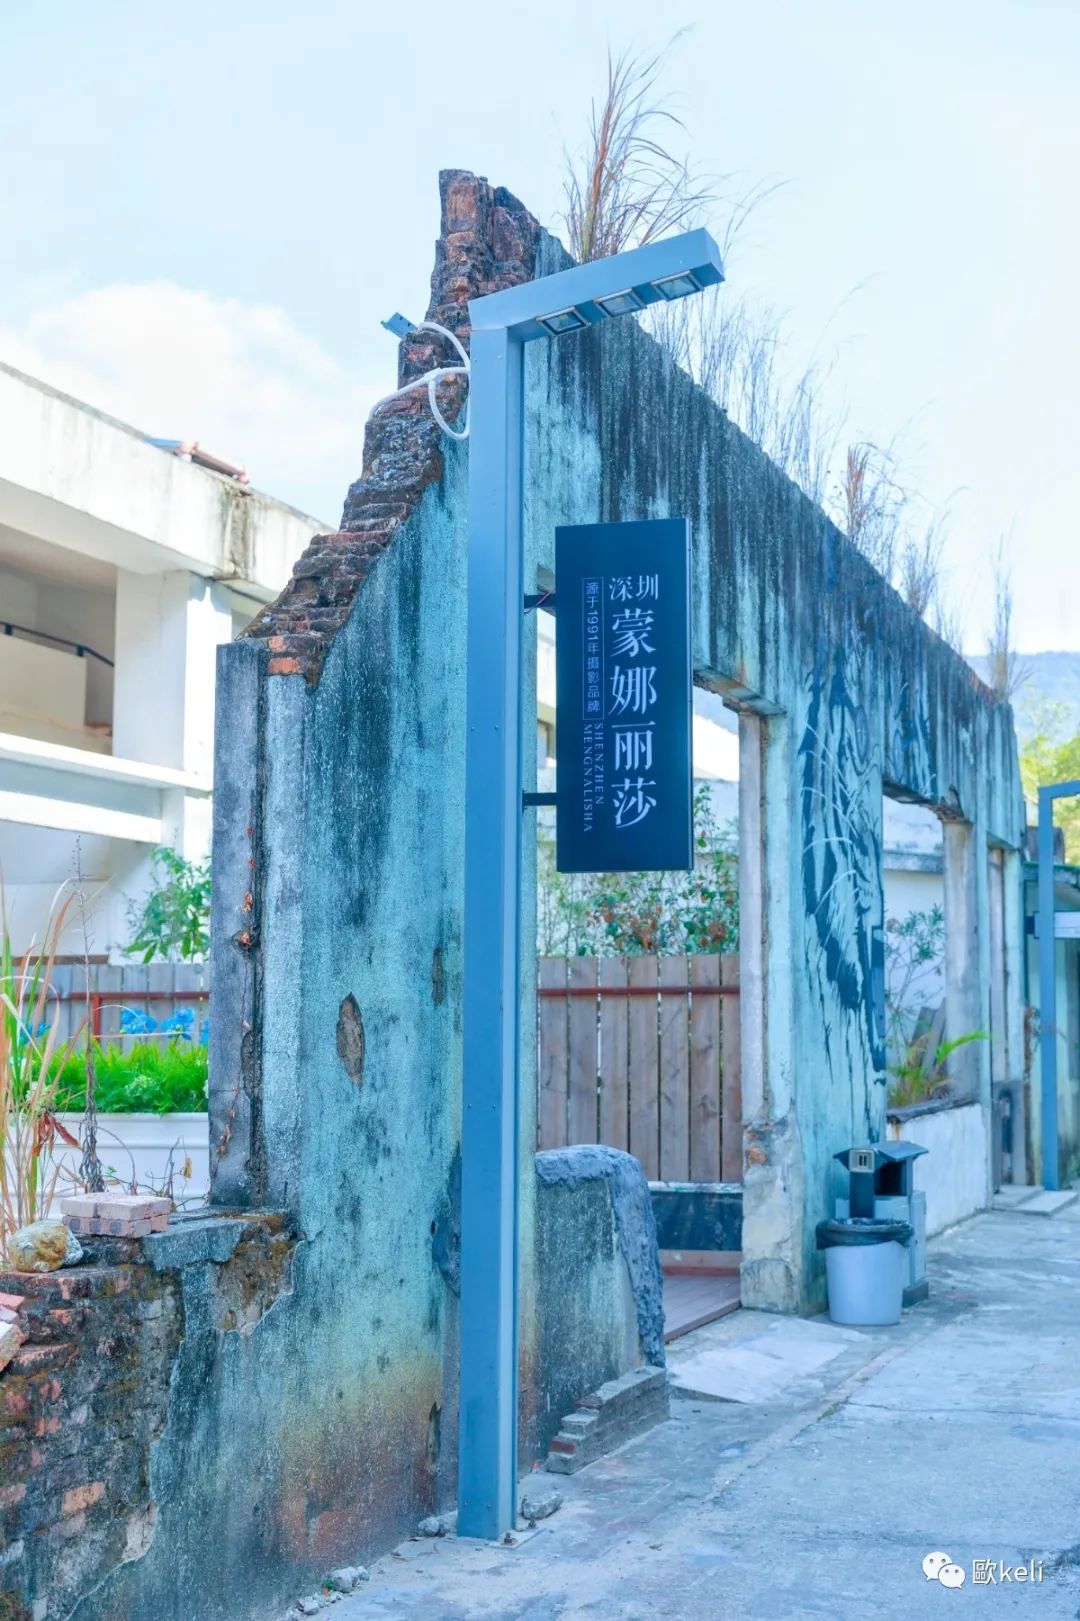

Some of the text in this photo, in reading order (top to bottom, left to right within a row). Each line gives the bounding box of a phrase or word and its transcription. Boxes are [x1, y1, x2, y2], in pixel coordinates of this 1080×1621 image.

[609, 574, 659, 602] 深圳
[586, 582, 600, 712] 源于1991年摄影品牌
[594, 722, 604, 805] SHENZHEN
[608, 608, 658, 829] 蒙娜丽莎
[583, 723, 593, 832] MENGNALISHA
